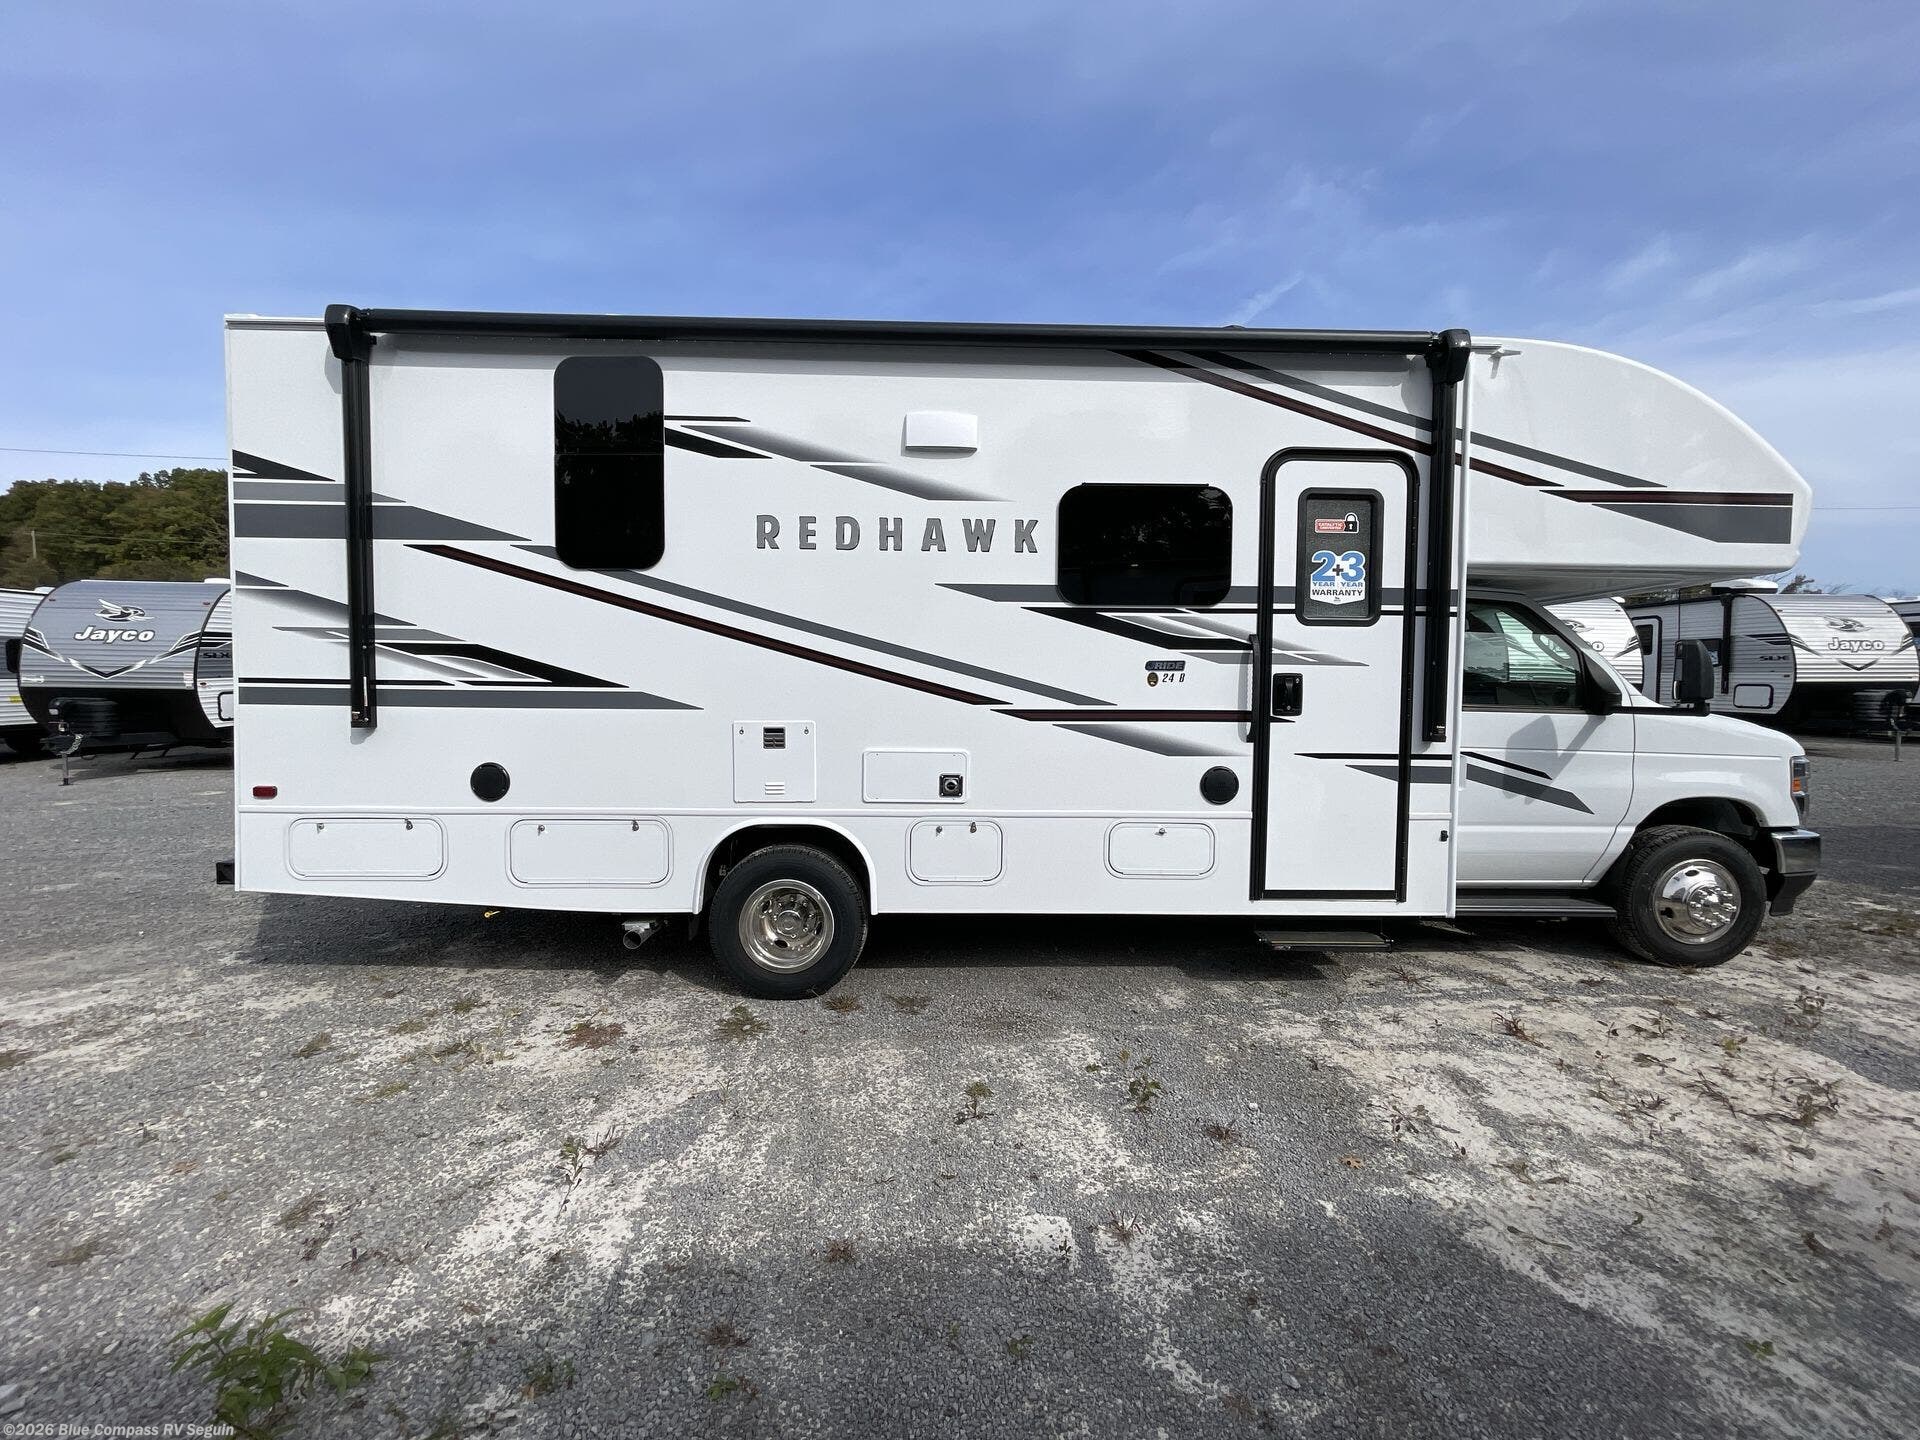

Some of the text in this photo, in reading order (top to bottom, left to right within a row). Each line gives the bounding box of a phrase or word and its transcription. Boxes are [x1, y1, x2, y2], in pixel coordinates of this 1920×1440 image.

[756, 514, 1039, 553] REDHAWK
[74, 625, 155, 644] Jayco
[1828, 637, 1885, 653] Jayco
[1162, 673, 1175, 682] 24
